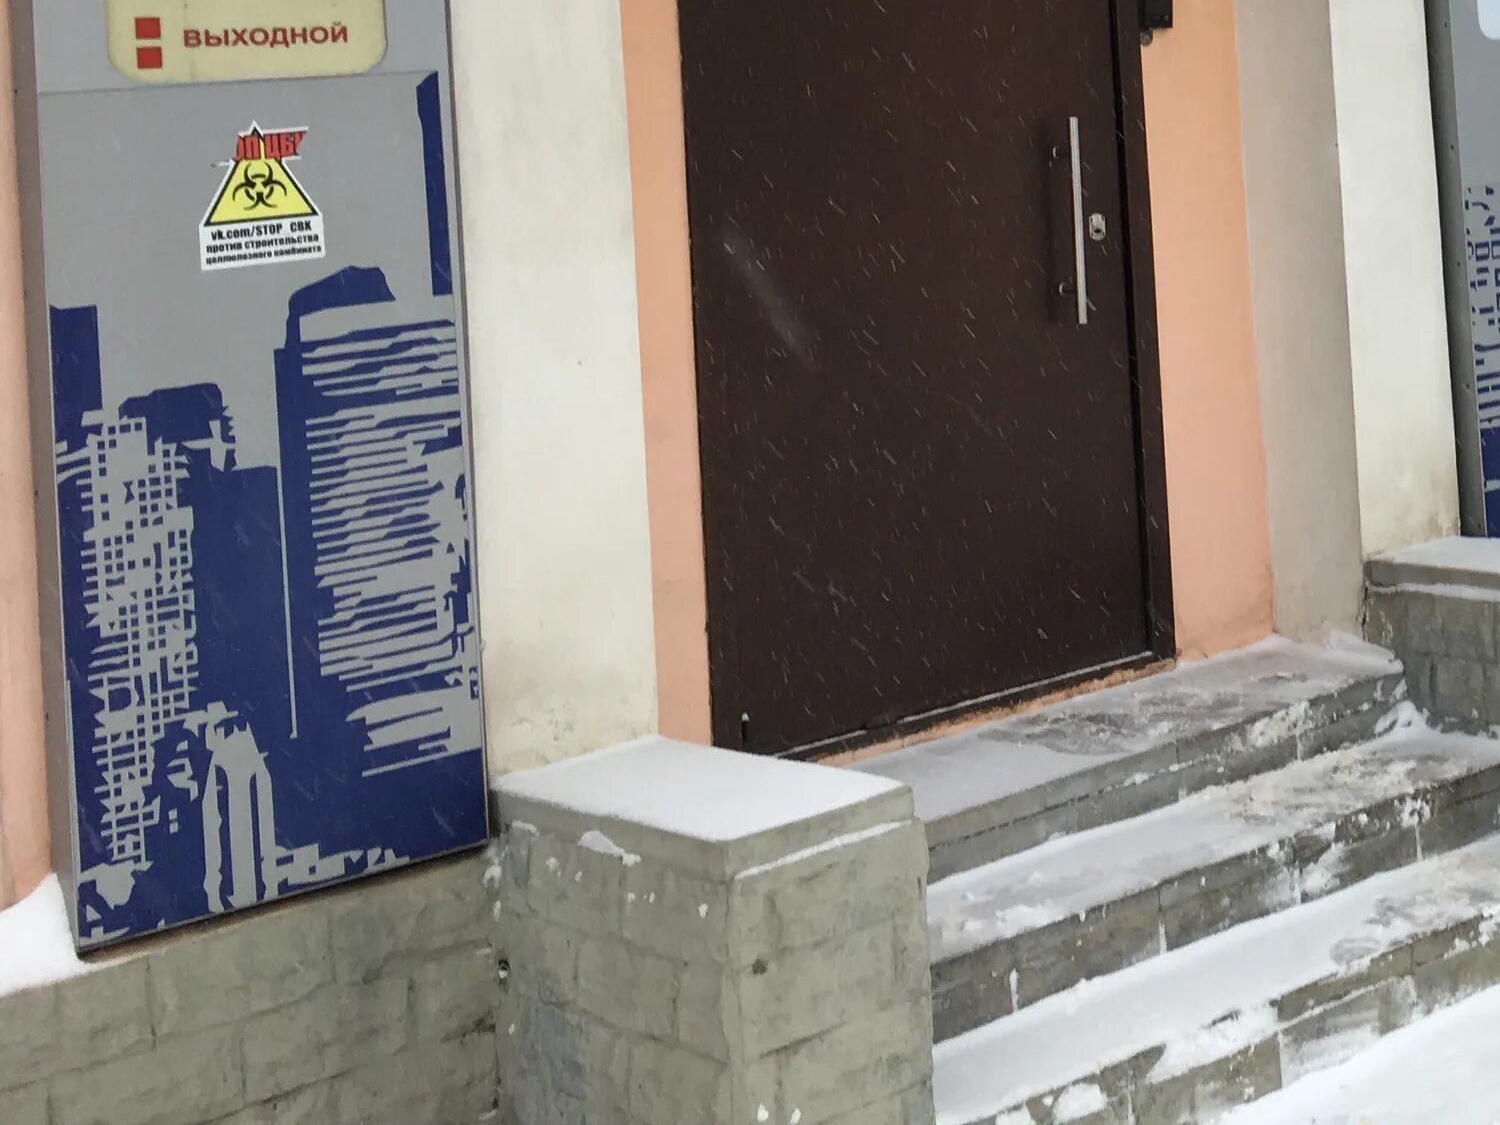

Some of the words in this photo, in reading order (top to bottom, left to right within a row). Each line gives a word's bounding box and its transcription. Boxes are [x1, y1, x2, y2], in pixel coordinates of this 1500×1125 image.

[183, 22, 349, 48] ВЫХОДНОЙ
[206, 242, 243, 254] против
[244, 234, 319, 250] строительства
